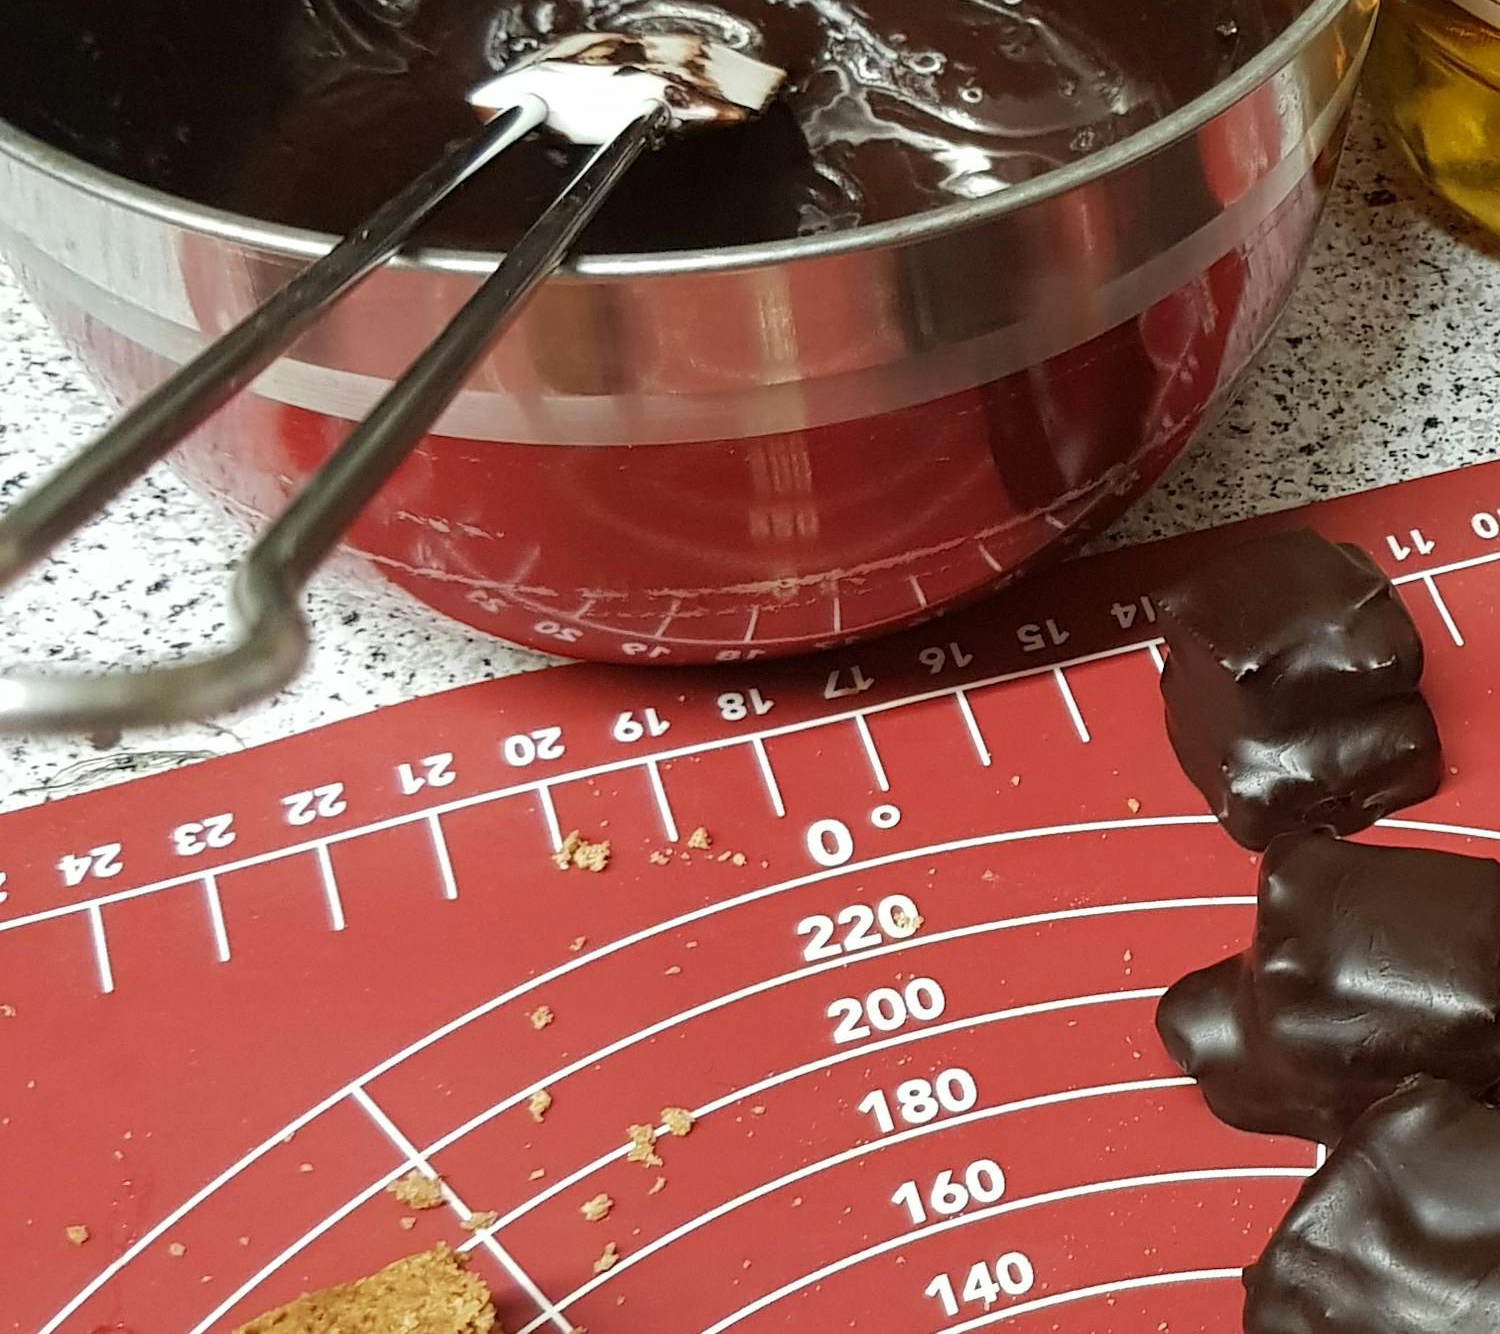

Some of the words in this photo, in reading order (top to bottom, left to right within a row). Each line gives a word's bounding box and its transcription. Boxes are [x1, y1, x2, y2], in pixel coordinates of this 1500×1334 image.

[1387, 530, 1434, 560] 11
[1111, 597, 1155, 628] 14
[1017, 619, 1069, 651] 15
[919, 642, 973, 674] 16
[823, 667, 874, 699] 17
[717, 689, 773, 720] 18
[613, 709, 669, 742] 19
[504, 727, 564, 766] 20
[397, 753, 455, 794] 21
[281, 783, 346, 825] 22
[170, 814, 235, 855] 23
[57, 843, 122, 885] 24
[797, 893, 918, 963] 220
[826, 976, 946, 1045] 200
[857, 1068, 978, 1135] 180
[890, 1159, 1007, 1226] 160
[924, 1250, 1034, 1317] 140
